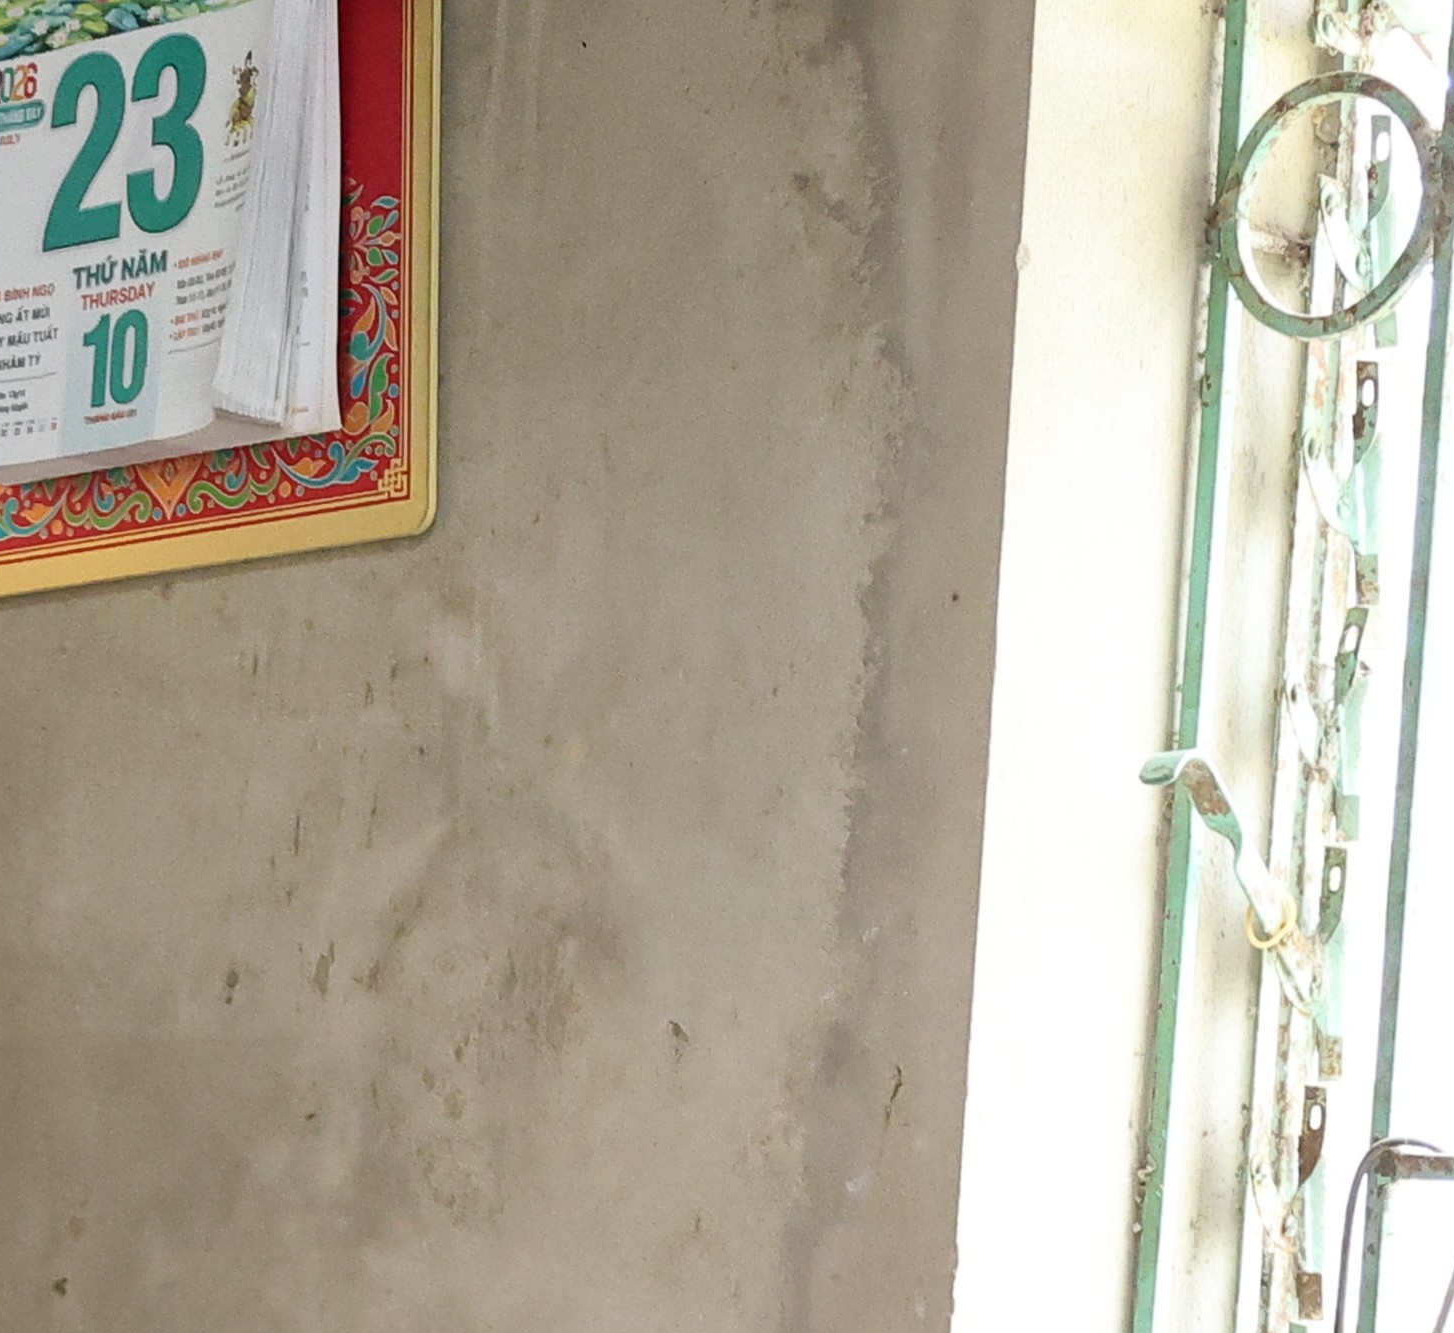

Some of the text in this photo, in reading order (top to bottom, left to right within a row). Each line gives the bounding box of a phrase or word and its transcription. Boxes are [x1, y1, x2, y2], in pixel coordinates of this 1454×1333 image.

[43, 32, 208, 252] 23
[72, 254, 118, 290] THỨ
[121, 248, 168, 281] NĂM
[81, 281, 156, 311] THURSDAY
[82, 309, 148, 408] 10
